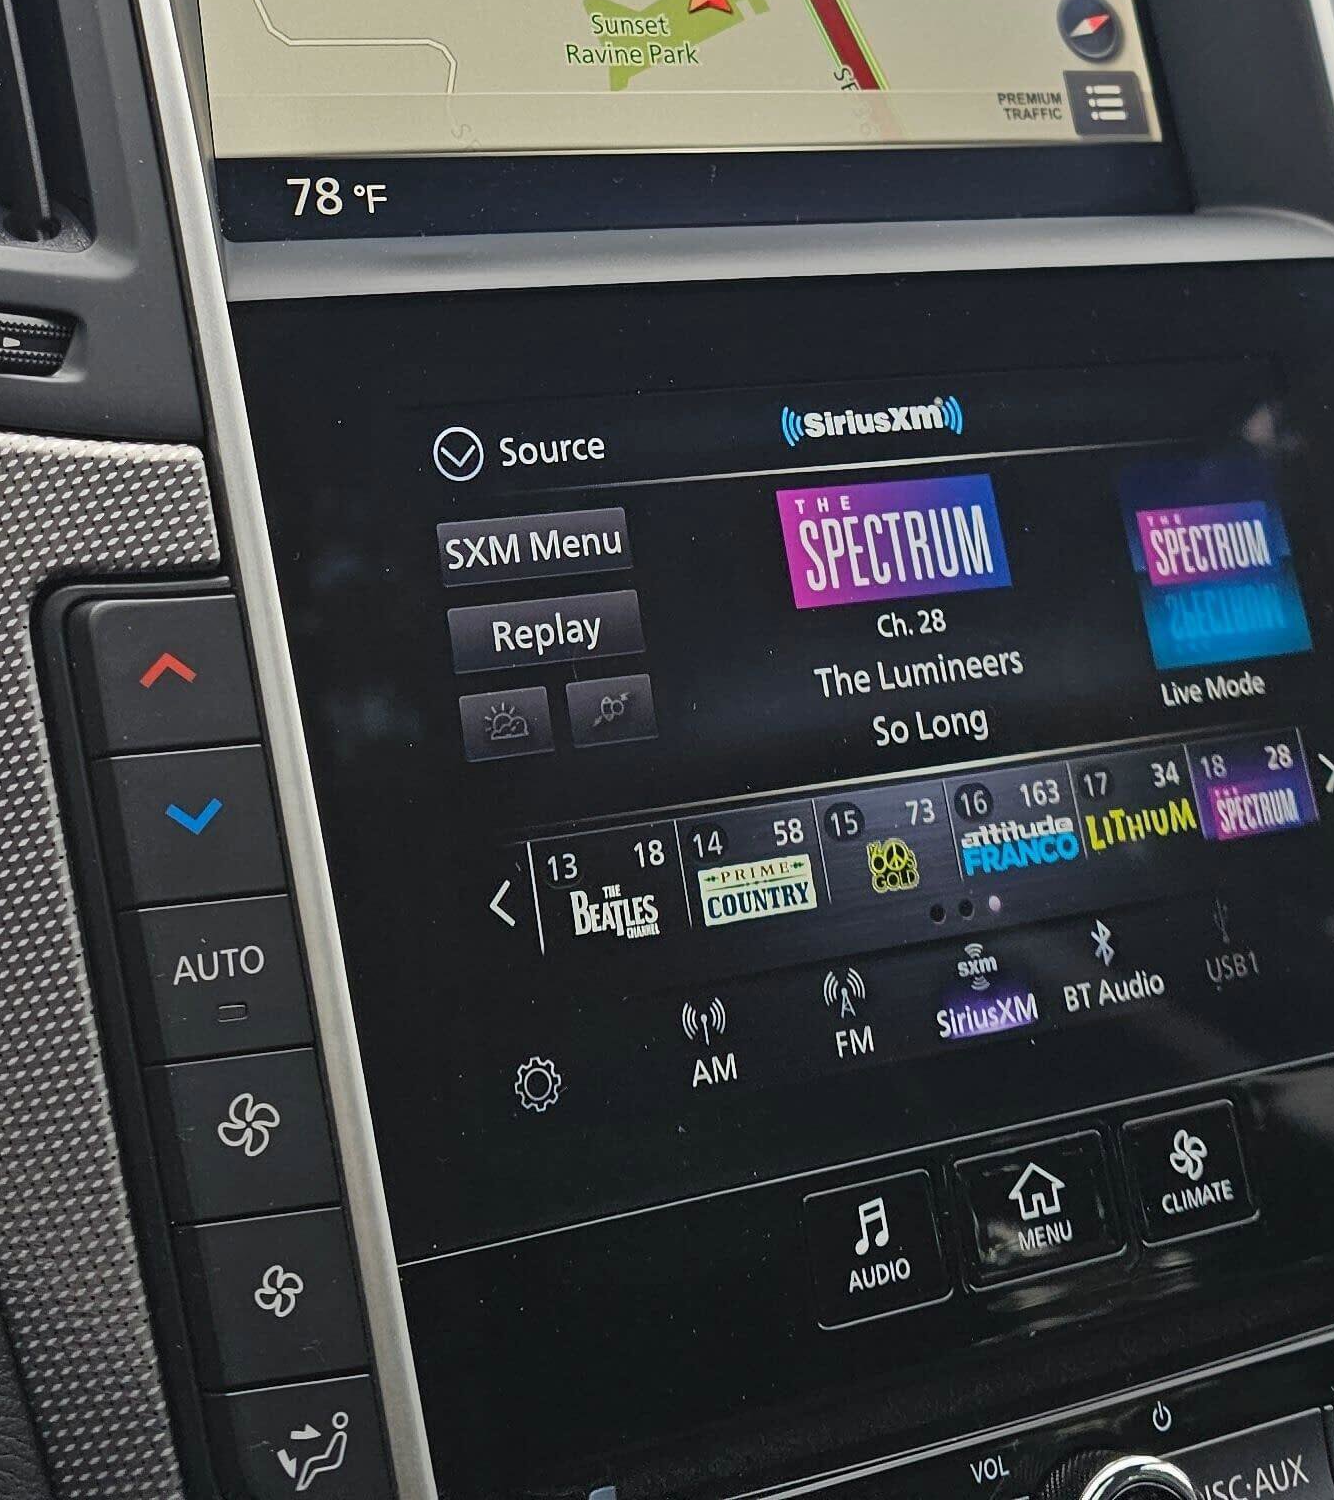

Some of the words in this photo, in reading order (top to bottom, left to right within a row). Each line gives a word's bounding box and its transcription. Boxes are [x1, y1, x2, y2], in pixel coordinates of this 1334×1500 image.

[591, 14, 668, 36] Sunset
[566, 43, 642, 65] Ravine
[650, 43, 699, 65] Park
[997, 91, 1063, 106] PREMIUM
[1003, 107, 1063, 121] TRAFFIC
[286, 177, 343, 216] 78
[499, 435, 605, 468] Source
[795, 495, 852, 515] THE
[445, 532, 521, 571] SXM
[530, 530, 622, 563] Menu
[799, 504, 995, 592] SPECTRUM
[1149, 519, 1272, 577] SPECTRUM
[492, 613, 602, 655] Replay
[877, 613, 913, 638] Ch.
[919, 608, 947, 634] 28
[813, 663, 871, 698] The
[877, 650, 1025, 692] Lumineers
[1160, 681, 1203, 707] Live
[1205, 671, 1266, 702] Mode
[872, 715, 909, 747] So
[915, 708, 990, 742] Long
[1201, 754, 1227, 780] 18
[1266, 744, 1294, 770] 28
[1083, 771, 1109, 798] 17
[1152, 760, 1180, 789] 34
[960, 788, 988, 817] 16
[1019, 779, 1061, 808] 163
[830, 809, 858, 837] 15
[905, 797, 936, 826] 73
[1216, 787, 1300, 834] SPECTRUM
[693, 830, 724, 858] 14
[773, 818, 805, 846] 58
[547, 853, 579, 882] 13
[633, 839, 665, 868] 18
[963, 830, 1080, 876] FRANCO
[720, 860, 791, 884] PRIME
[872, 869, 920, 894] GOLD
[602, 884, 621, 899] THE
[707, 882, 809, 919] COUNTRY
[172, 945, 265, 986] AUTO
[957, 956, 998, 977] sxm
[1206, 951, 1260, 983] USB1
[1064, 984, 1090, 1012] BT
[1098, 971, 1165, 1004] Audio
[936, 993, 1039, 1038] SiriusXM
[836, 1026, 875, 1059] FM
[692, 1053, 738, 1088] AM
[1161, 1180, 1234, 1215] CLIMATE
[1017, 1221, 1073, 1252] MENU
[848, 1258, 911, 1293] AUDIO
[970, 1456, 1010, 1485] VOL
